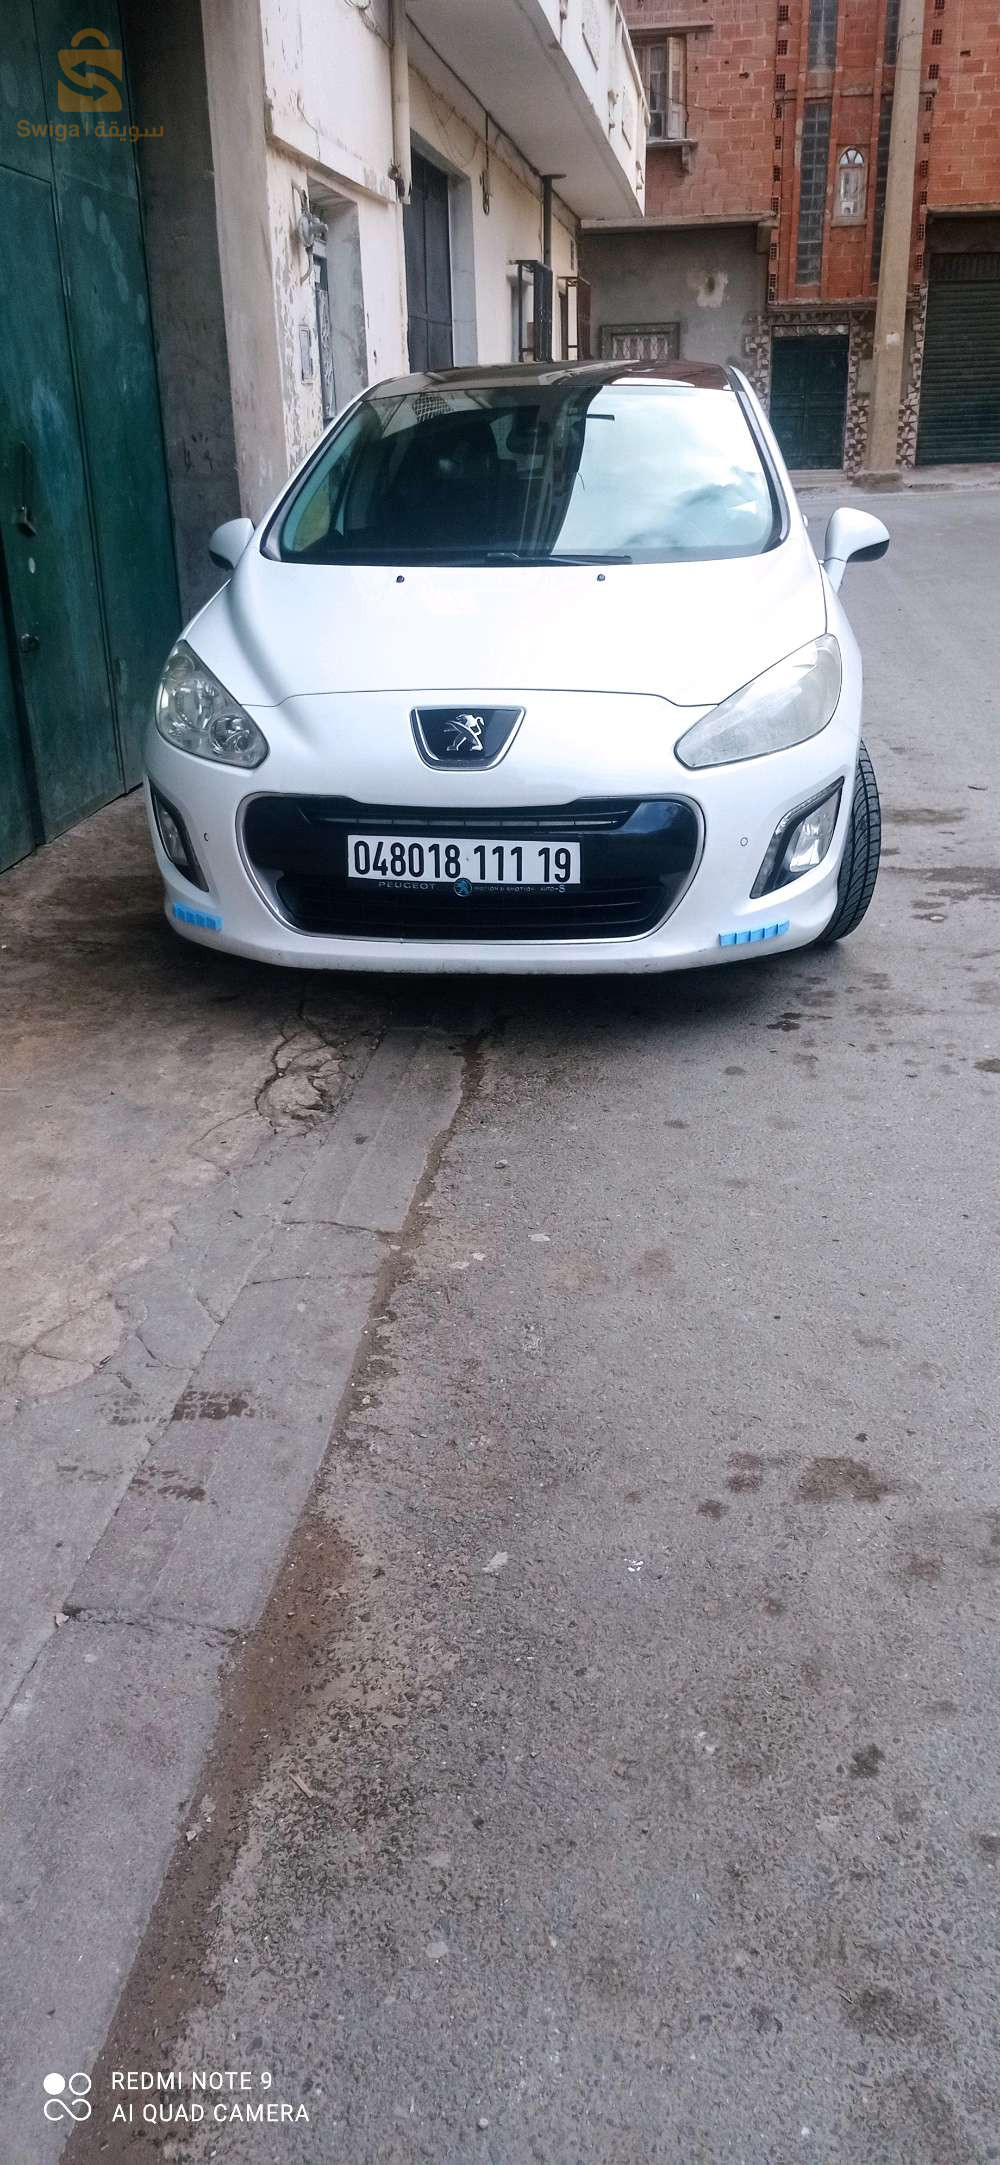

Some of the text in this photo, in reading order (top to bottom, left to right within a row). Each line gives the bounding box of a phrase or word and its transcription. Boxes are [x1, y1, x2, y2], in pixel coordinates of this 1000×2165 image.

[353, 840, 571, 883] 048018 111 19
[378, 881, 436, 890] PEUGEOT
